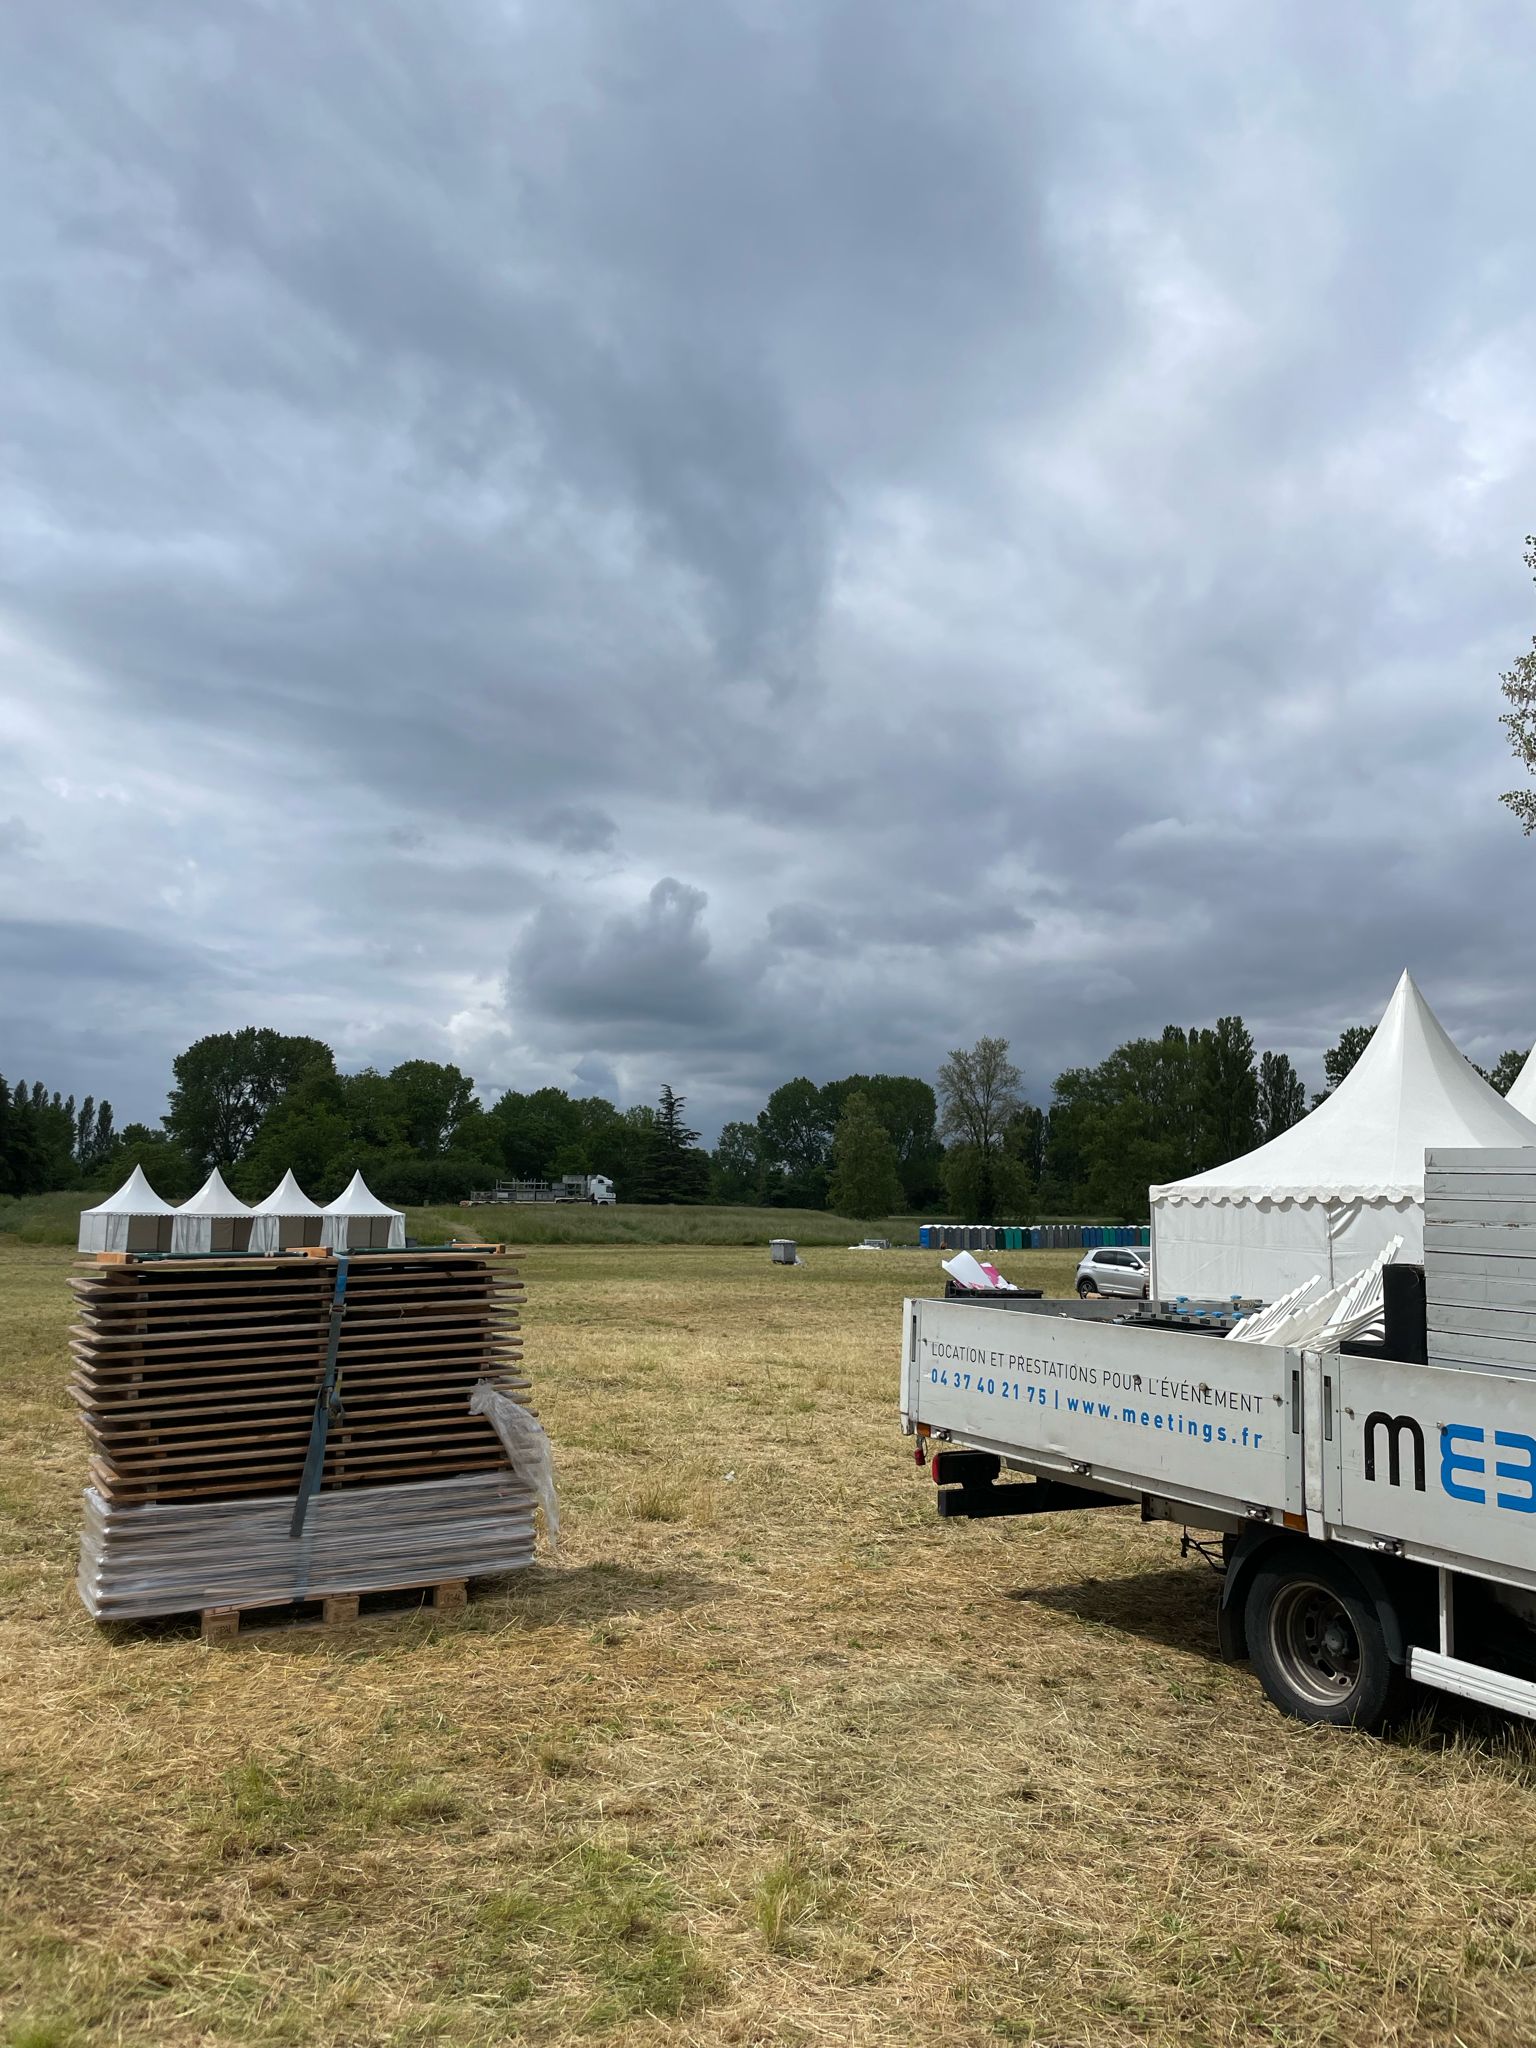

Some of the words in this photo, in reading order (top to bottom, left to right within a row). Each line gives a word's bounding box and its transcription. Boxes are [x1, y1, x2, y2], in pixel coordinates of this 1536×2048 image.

[931, 1341, 986, 1365] LOCATION
[990, 1351, 1005, 1367] ET
[1009, 1355, 1097, 1384] PRESTATIONS
[1103, 1370, 1142, 1393] POUR
[1149, 1376, 1263, 1413] L'ÉVÉNEMENT
[931, 1368, 948, 1386] 04
[953, 1372, 971, 1389] 37
[977, 1377, 995, 1394] 40
[1001, 1381, 1019, 1399] 21
[1027, 1386, 1046, 1404] 75
[1067, 1397, 1263, 1448] www.meetings.fr
